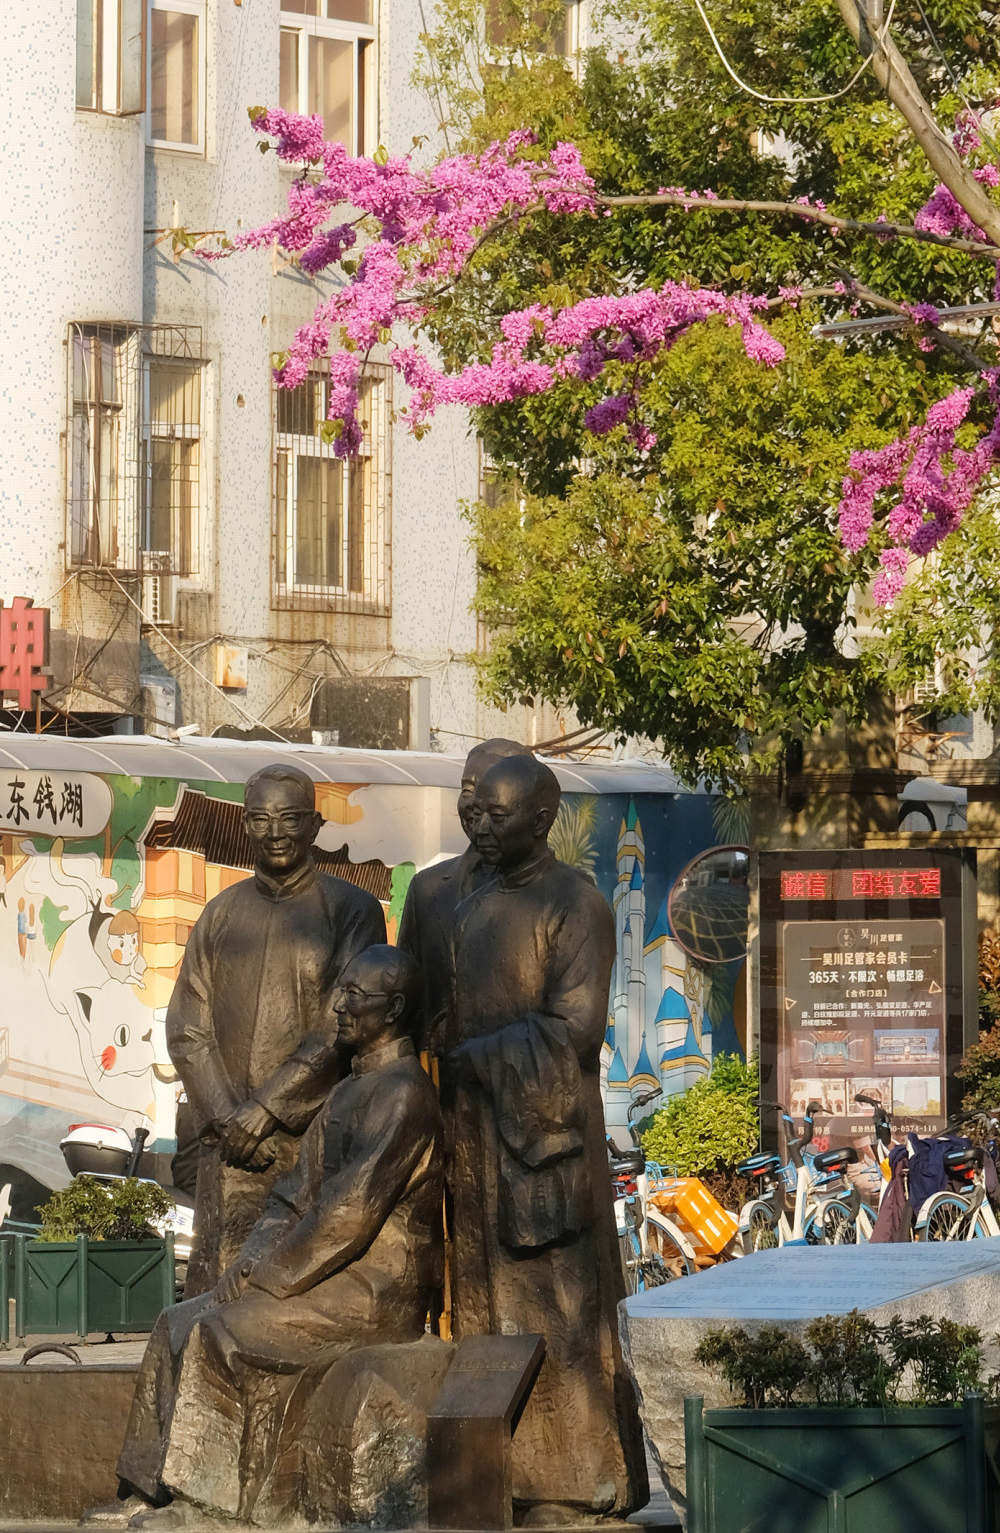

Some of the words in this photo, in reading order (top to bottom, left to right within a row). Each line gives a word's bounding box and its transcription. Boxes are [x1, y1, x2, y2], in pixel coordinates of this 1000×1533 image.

[0, 774, 84, 828] 东钱湖
[781, 872, 827, 897] 诚信
[852, 868, 941, 897] 团结友爱
